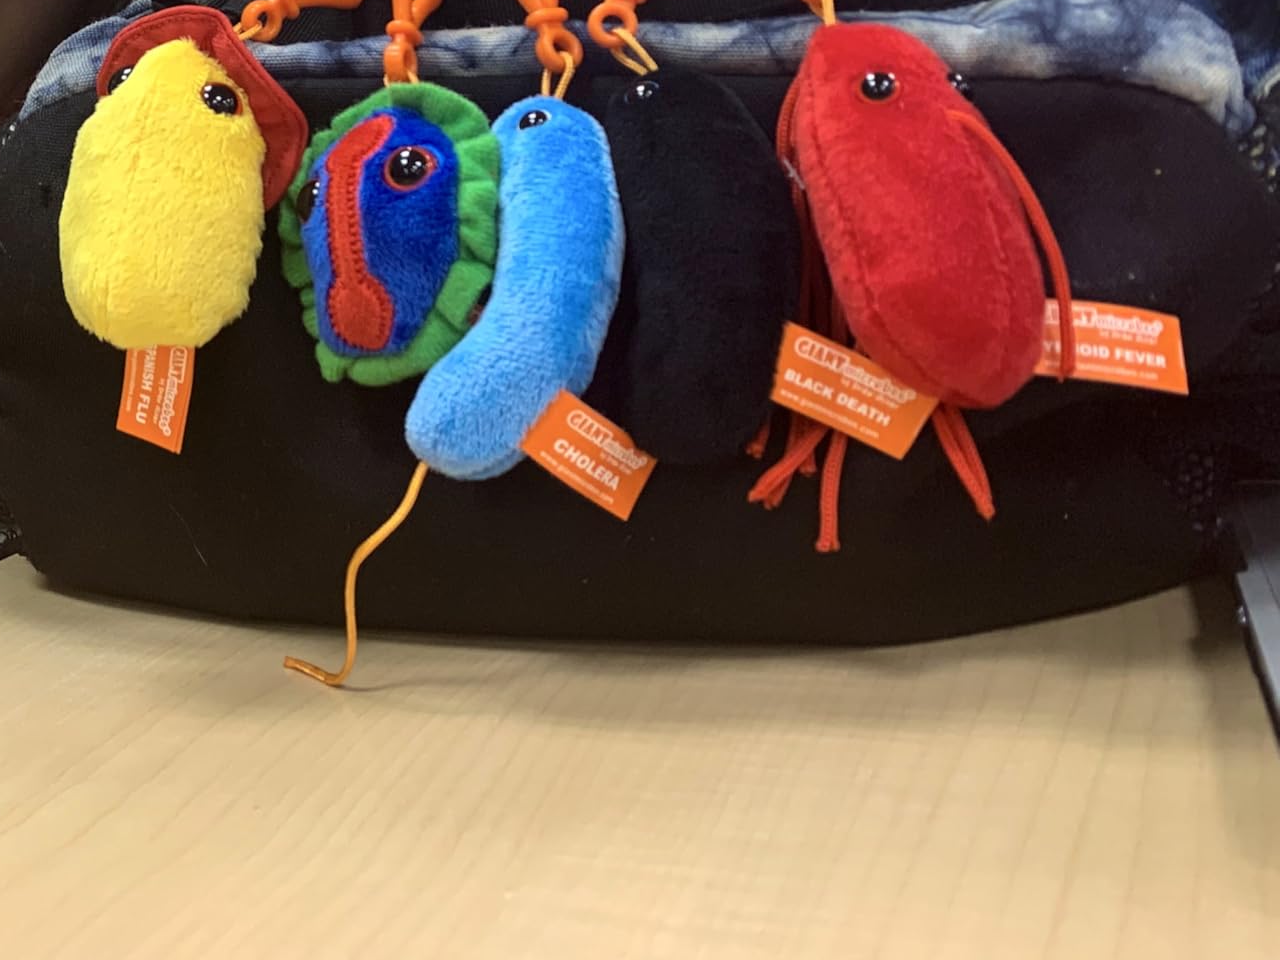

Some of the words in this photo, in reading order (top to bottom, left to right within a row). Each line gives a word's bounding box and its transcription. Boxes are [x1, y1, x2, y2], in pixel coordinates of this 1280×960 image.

[1115, 347, 1167, 369] FEVER
[136, 393, 152, 425] FLU
[784, 368, 835, 400] BLACK
[837, 391, 892, 427] DEATH
[554, 438, 621, 491] CHOLERA
